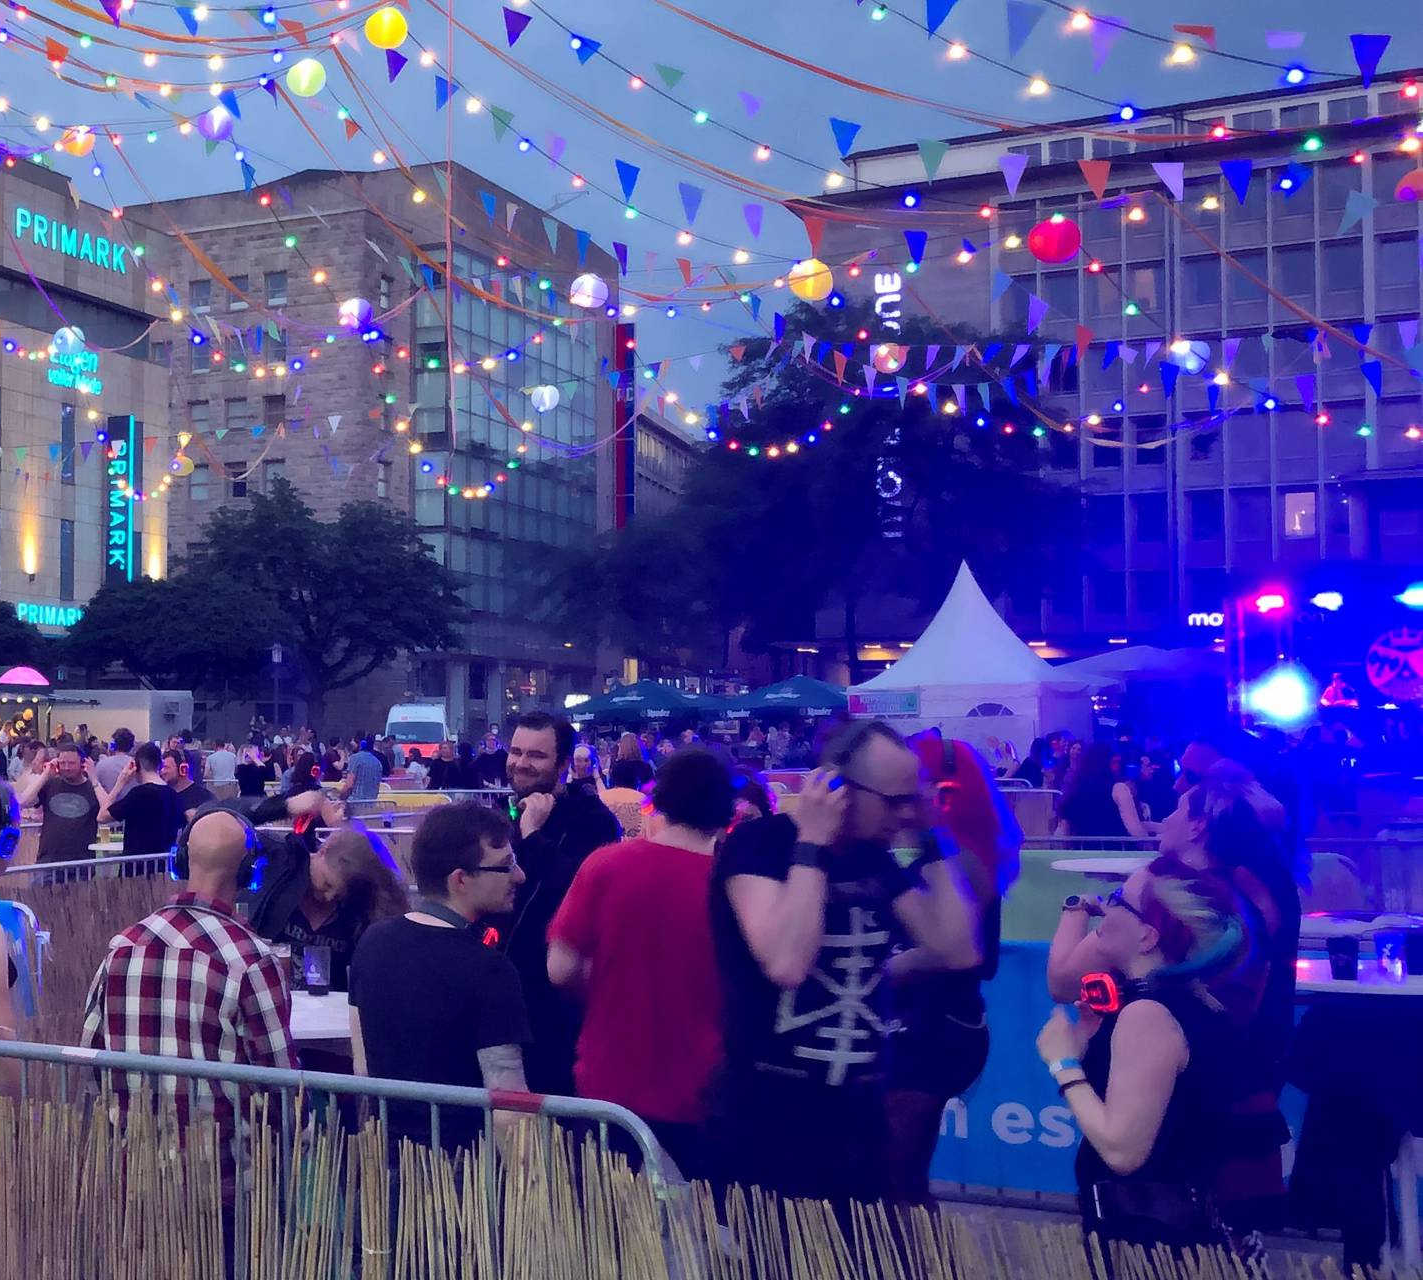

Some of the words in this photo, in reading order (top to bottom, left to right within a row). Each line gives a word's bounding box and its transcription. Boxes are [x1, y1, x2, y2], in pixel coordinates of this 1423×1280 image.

[15, 206, 126, 275] PRIMARK
[108, 441, 127, 567] PRIMARK
[1188, 612, 1225, 627] mo
[991, 1102, 1077, 1148] es
